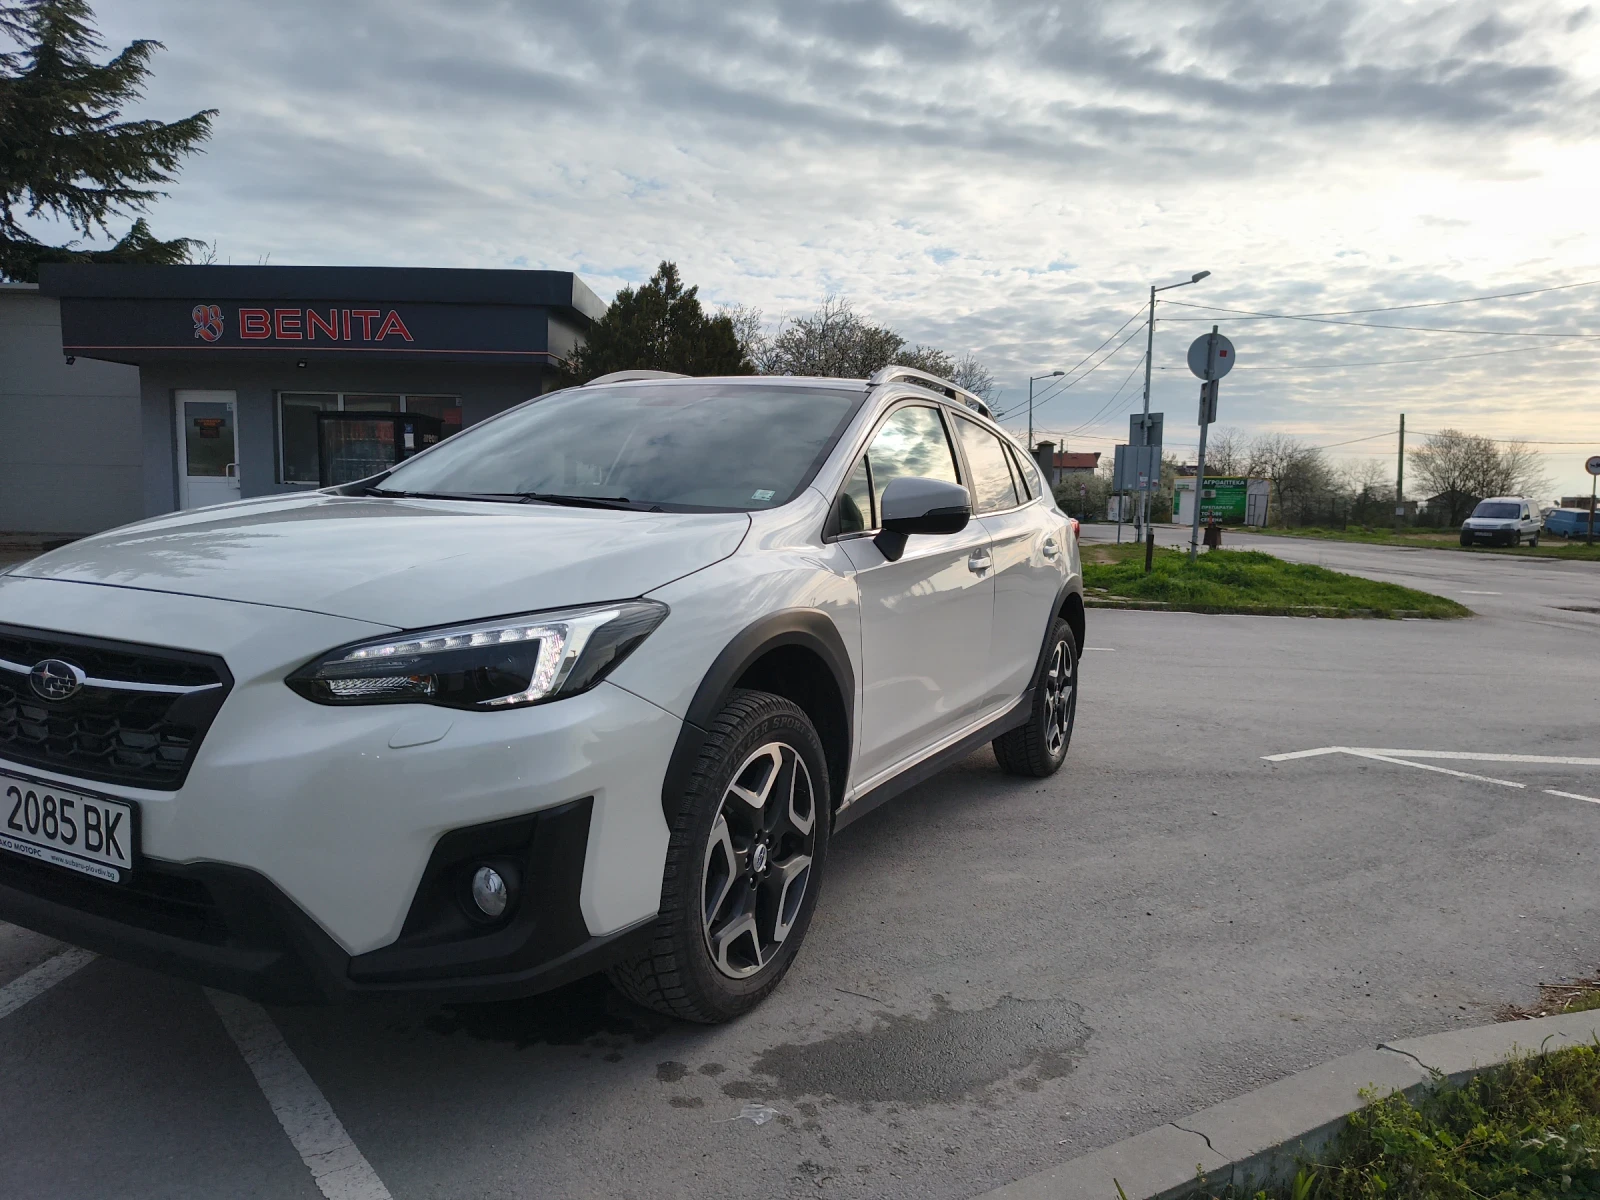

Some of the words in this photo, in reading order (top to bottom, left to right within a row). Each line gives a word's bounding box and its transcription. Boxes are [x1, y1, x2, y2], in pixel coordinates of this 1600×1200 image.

[238, 308, 414, 342] BENITA
[773, 716, 806, 734] SPORT
[7, 785, 77, 845] 2085
[14, 843, 42, 858] МОТОРС
